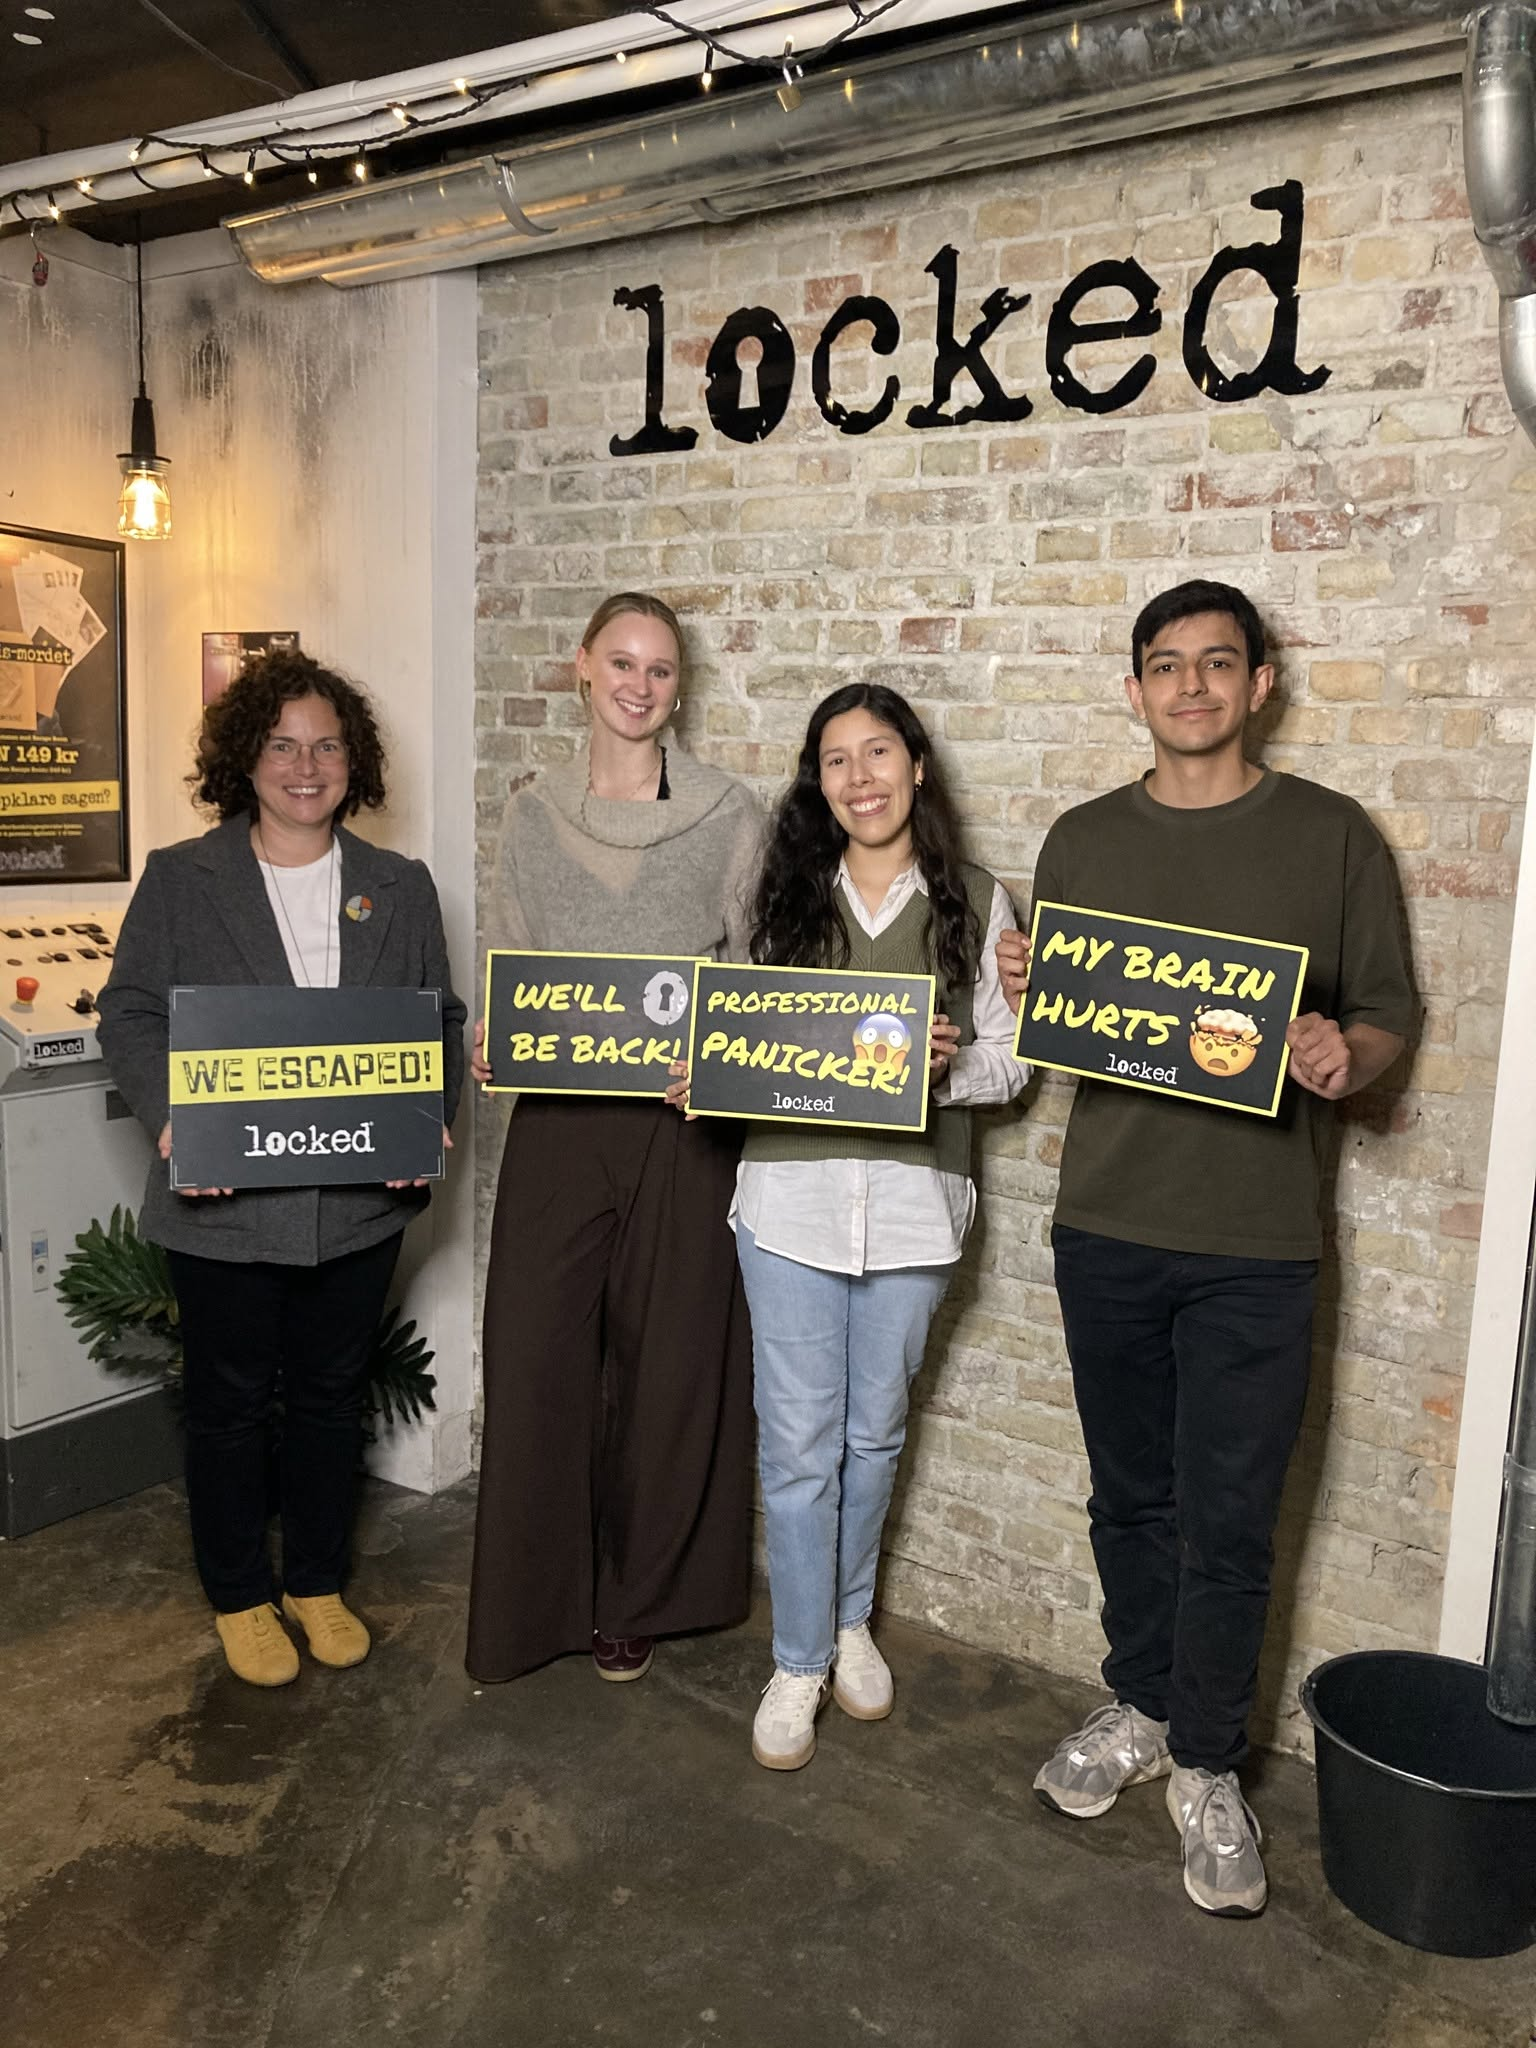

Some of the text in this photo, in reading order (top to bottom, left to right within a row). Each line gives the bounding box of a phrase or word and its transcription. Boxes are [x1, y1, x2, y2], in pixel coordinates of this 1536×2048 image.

[609, 179, 1333, 456] locked
[16, 745, 52, 763] 149
[56, 746, 79, 764] kr
[62, 788, 111, 808] sagen?
[1042, 930, 1276, 1001] MY BRAIN
[513, 982, 626, 1013] WE'LL
[707, 991, 918, 1015] PROFESSIONAL
[1031, 991, 1181, 1046] HURTS
[34, 1039, 83, 1058] locked
[510, 1032, 681, 1065] BE BACK!
[700, 1031, 911, 1095] PANICKER!
[182, 1051, 432, 1094] WE ESCAPED!
[1105, 1052, 1178, 1085] locked
[771, 1091, 836, 1113] locked
[244, 1121, 376, 1157] locked
